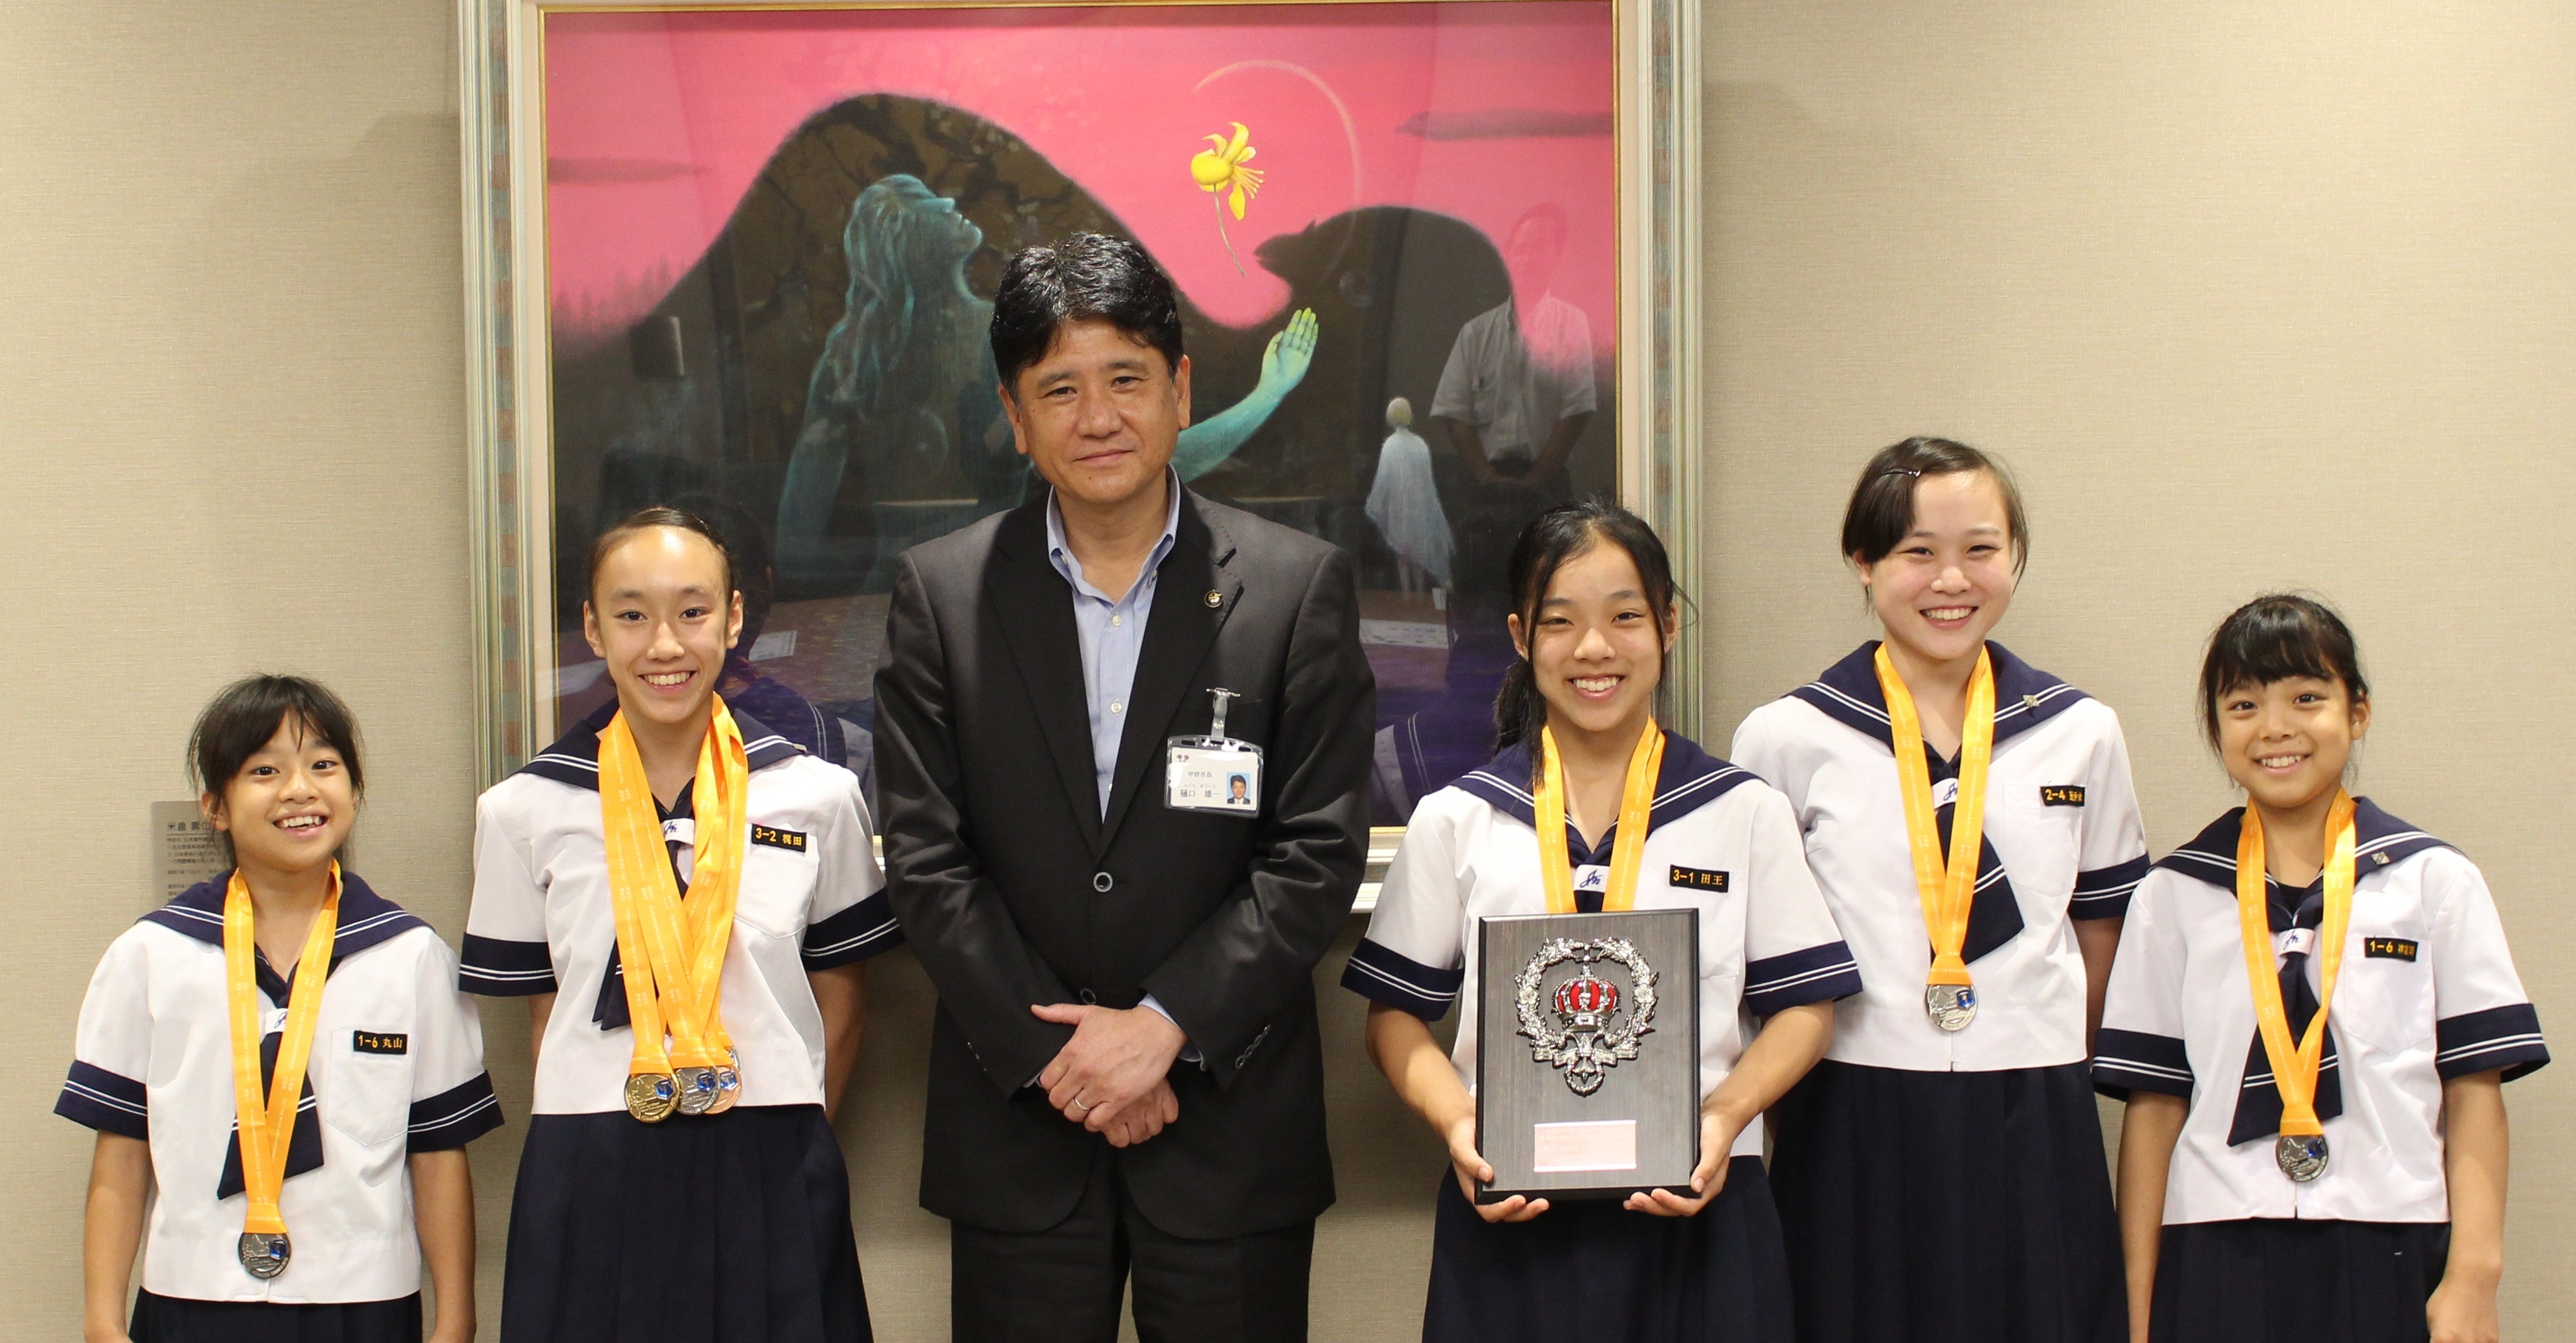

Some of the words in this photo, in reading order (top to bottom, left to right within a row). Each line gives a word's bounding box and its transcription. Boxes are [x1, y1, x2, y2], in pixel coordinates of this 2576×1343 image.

[2045, 788, 2066, 801] 2-4
[755, 827, 777, 842] 3-2
[1673, 869, 1694, 884] 3-1
[2369, 940, 2394, 953] 1-6
[358, 1034, 378, 1048] 1-6
[382, 1037, 403, 1048] 丸山
